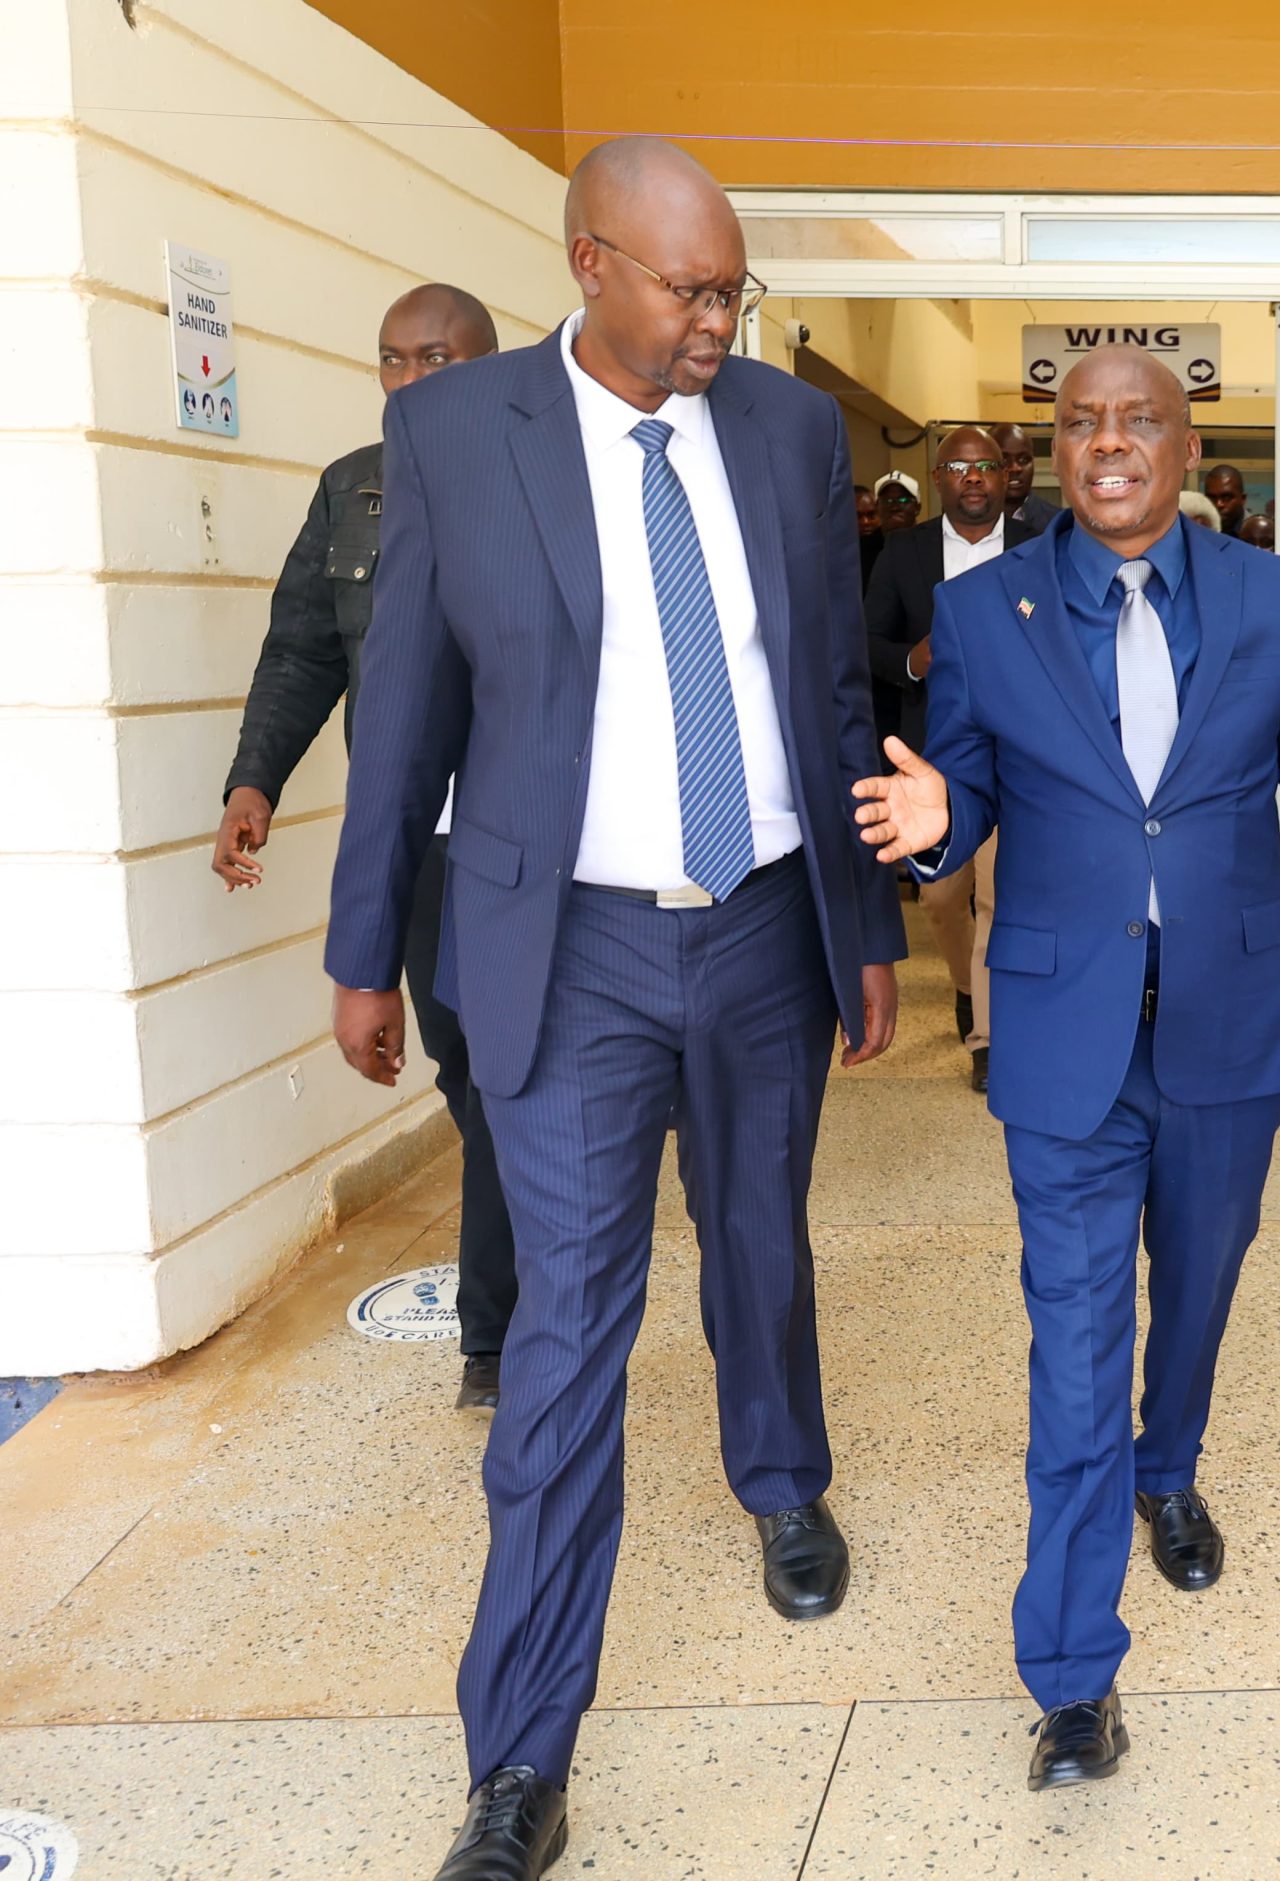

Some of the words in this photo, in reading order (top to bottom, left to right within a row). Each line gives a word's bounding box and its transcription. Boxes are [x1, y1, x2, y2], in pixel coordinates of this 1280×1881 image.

[187, 292, 216, 315] HAND
[178, 312, 228, 339] SANITIZER
[1064, 327, 1180, 347] WING
